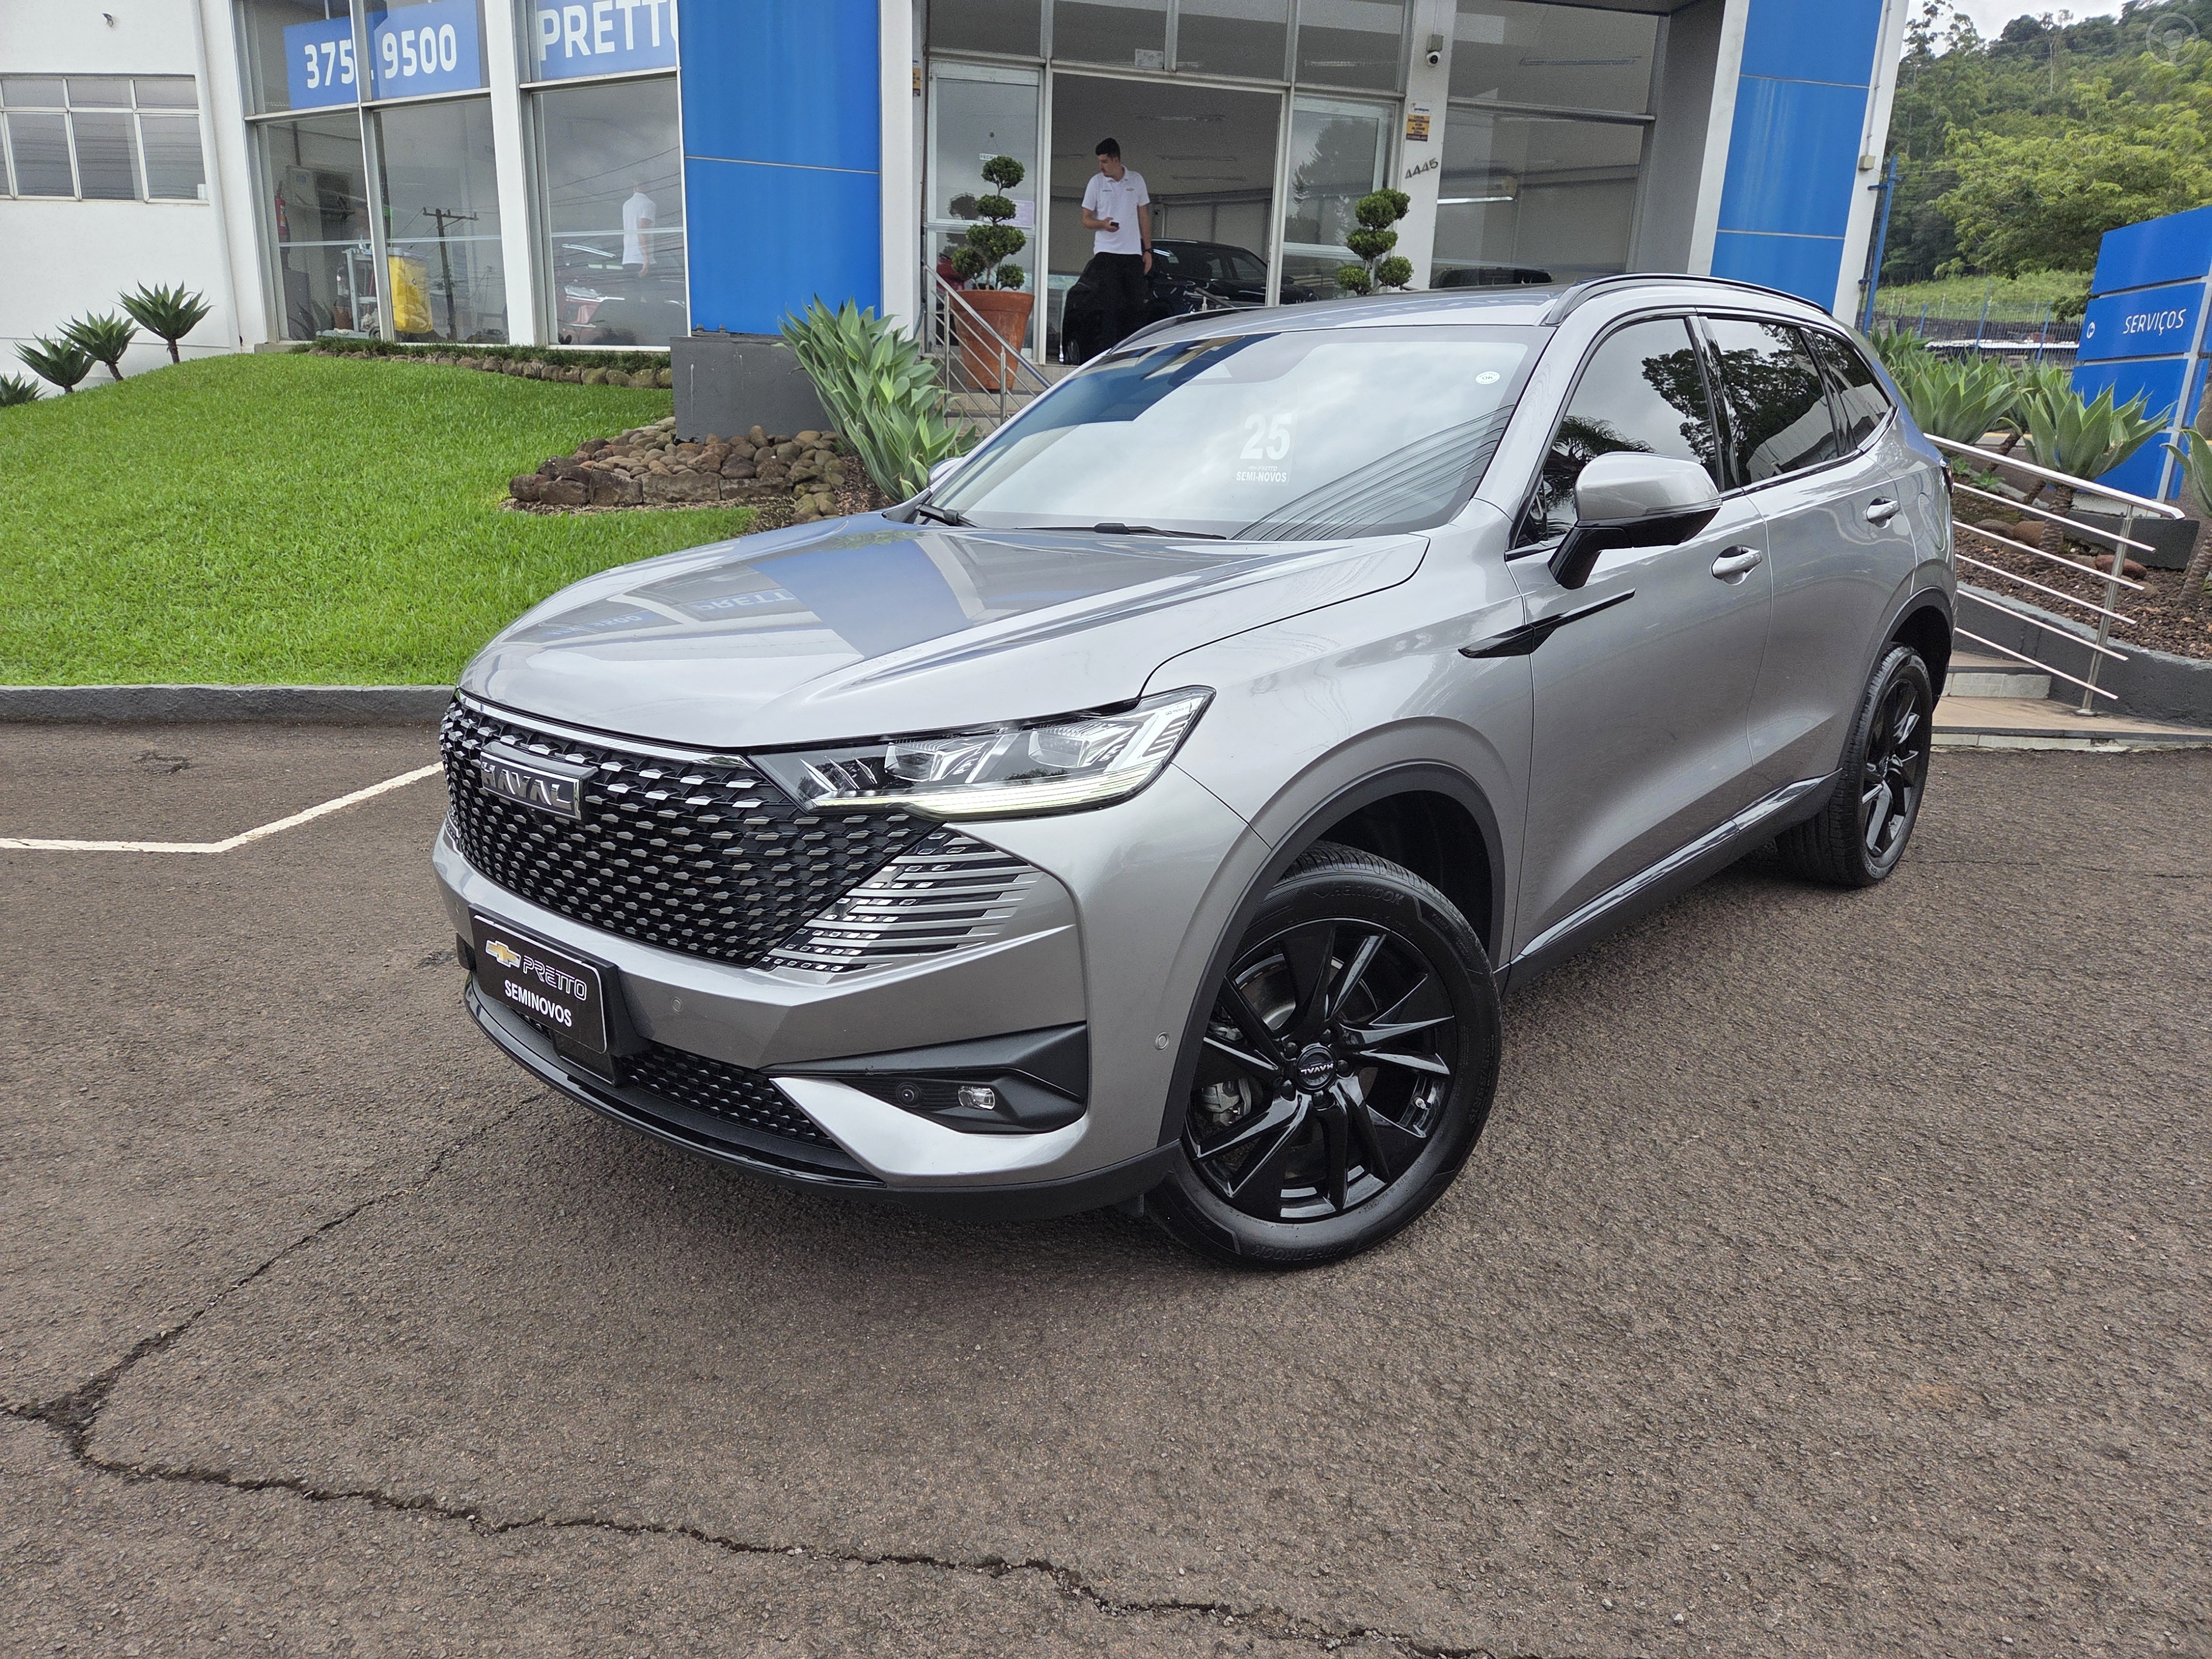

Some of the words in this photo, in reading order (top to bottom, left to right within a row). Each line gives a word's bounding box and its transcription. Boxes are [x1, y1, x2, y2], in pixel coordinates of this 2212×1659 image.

[1405, 158, 1439, 179] 4445
[2122, 309, 2187, 336] SERVIÇOS
[1240, 413, 1292, 460] 25
[481, 761, 572, 811] HAVAL
[523, 955, 587, 1001] PRETTO
[504, 979, 572, 1027] SEMINOVOS
[1300, 1063, 1334, 1074] HAVAL
[1411, 1161, 1423, 1172] DOT
